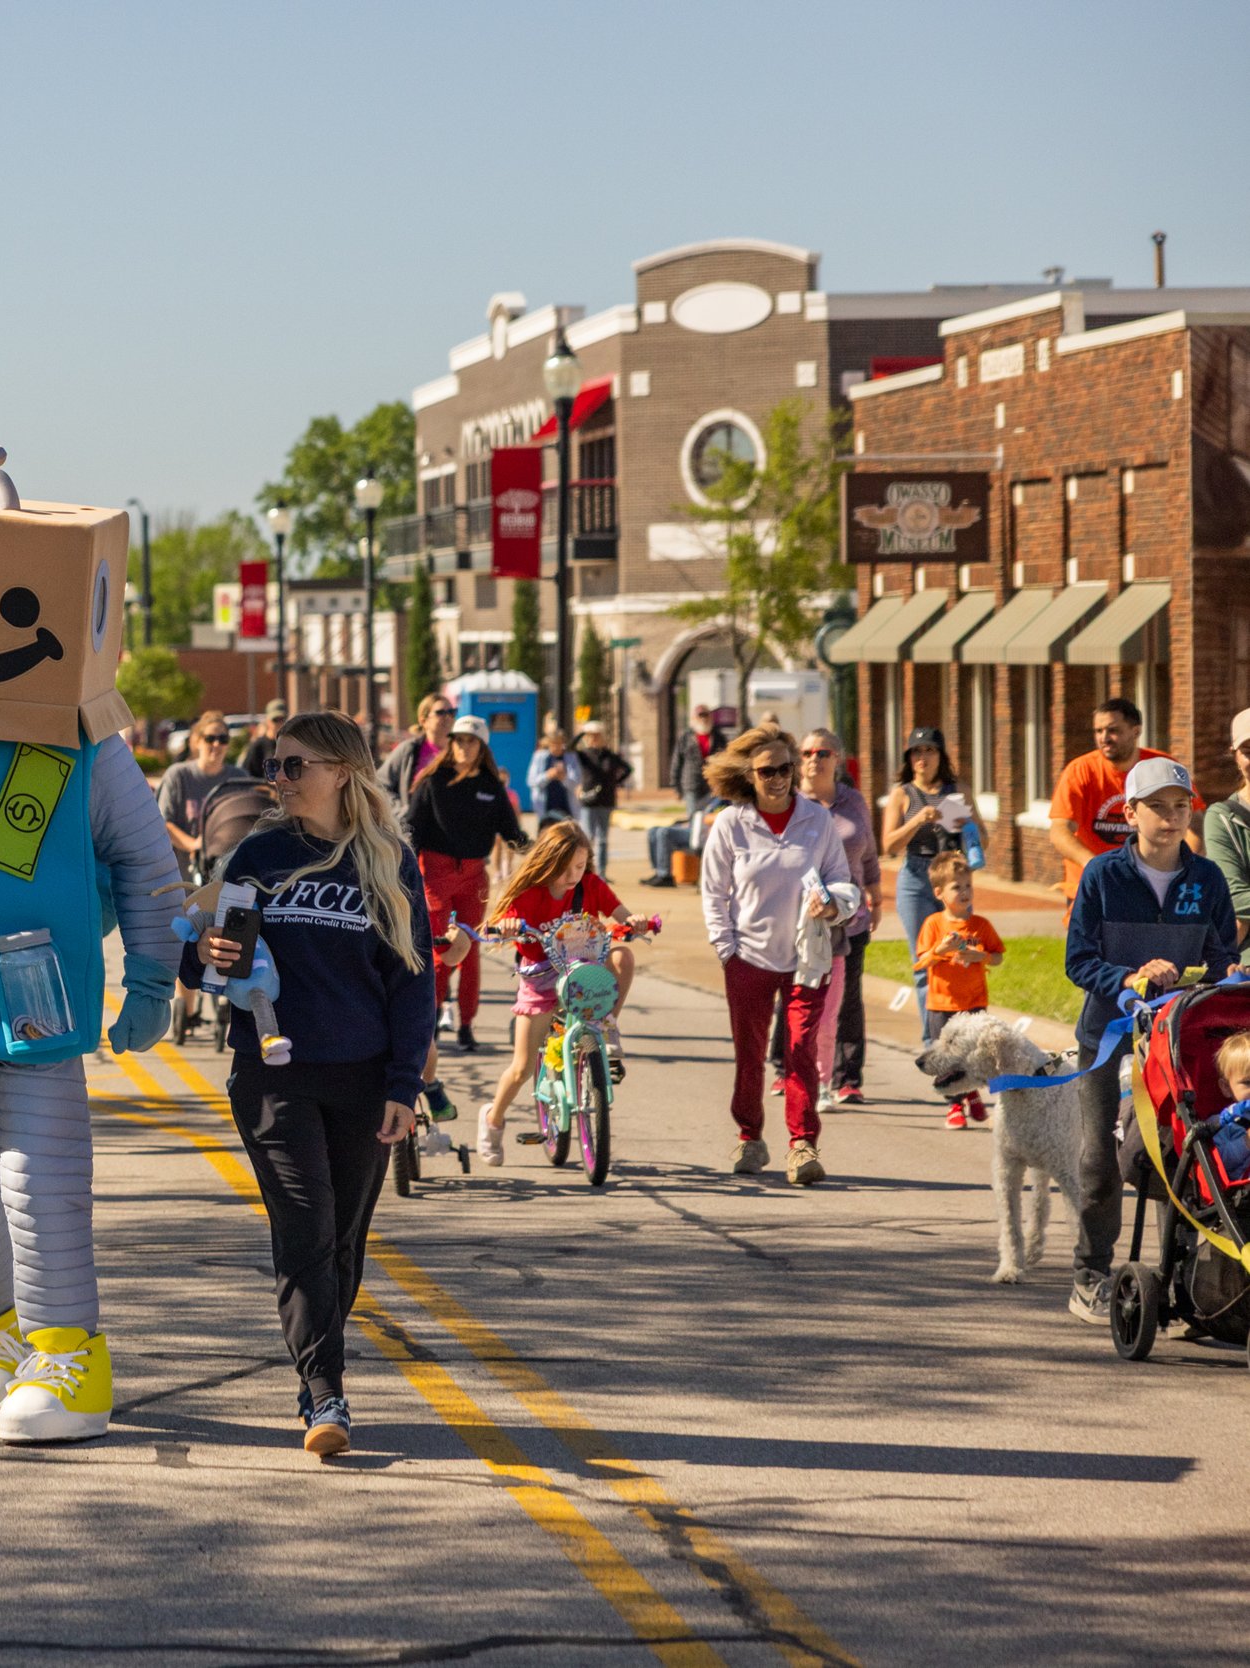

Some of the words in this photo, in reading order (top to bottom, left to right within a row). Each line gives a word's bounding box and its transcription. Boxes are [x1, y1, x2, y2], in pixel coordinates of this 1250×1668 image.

[886, 477, 952, 507] OWASSO
[878, 526, 956, 554] MUSEUM
[1095, 794, 1127, 820] OKLAHO
[1094, 821, 1139, 834] UNIVERS
[267, 880, 373, 914] TFCU
[1174, 901, 1202, 915] UA
[283, 914, 313, 924] Federal
[314, 916, 339, 929] Credit
[340, 920, 366, 932] Union
